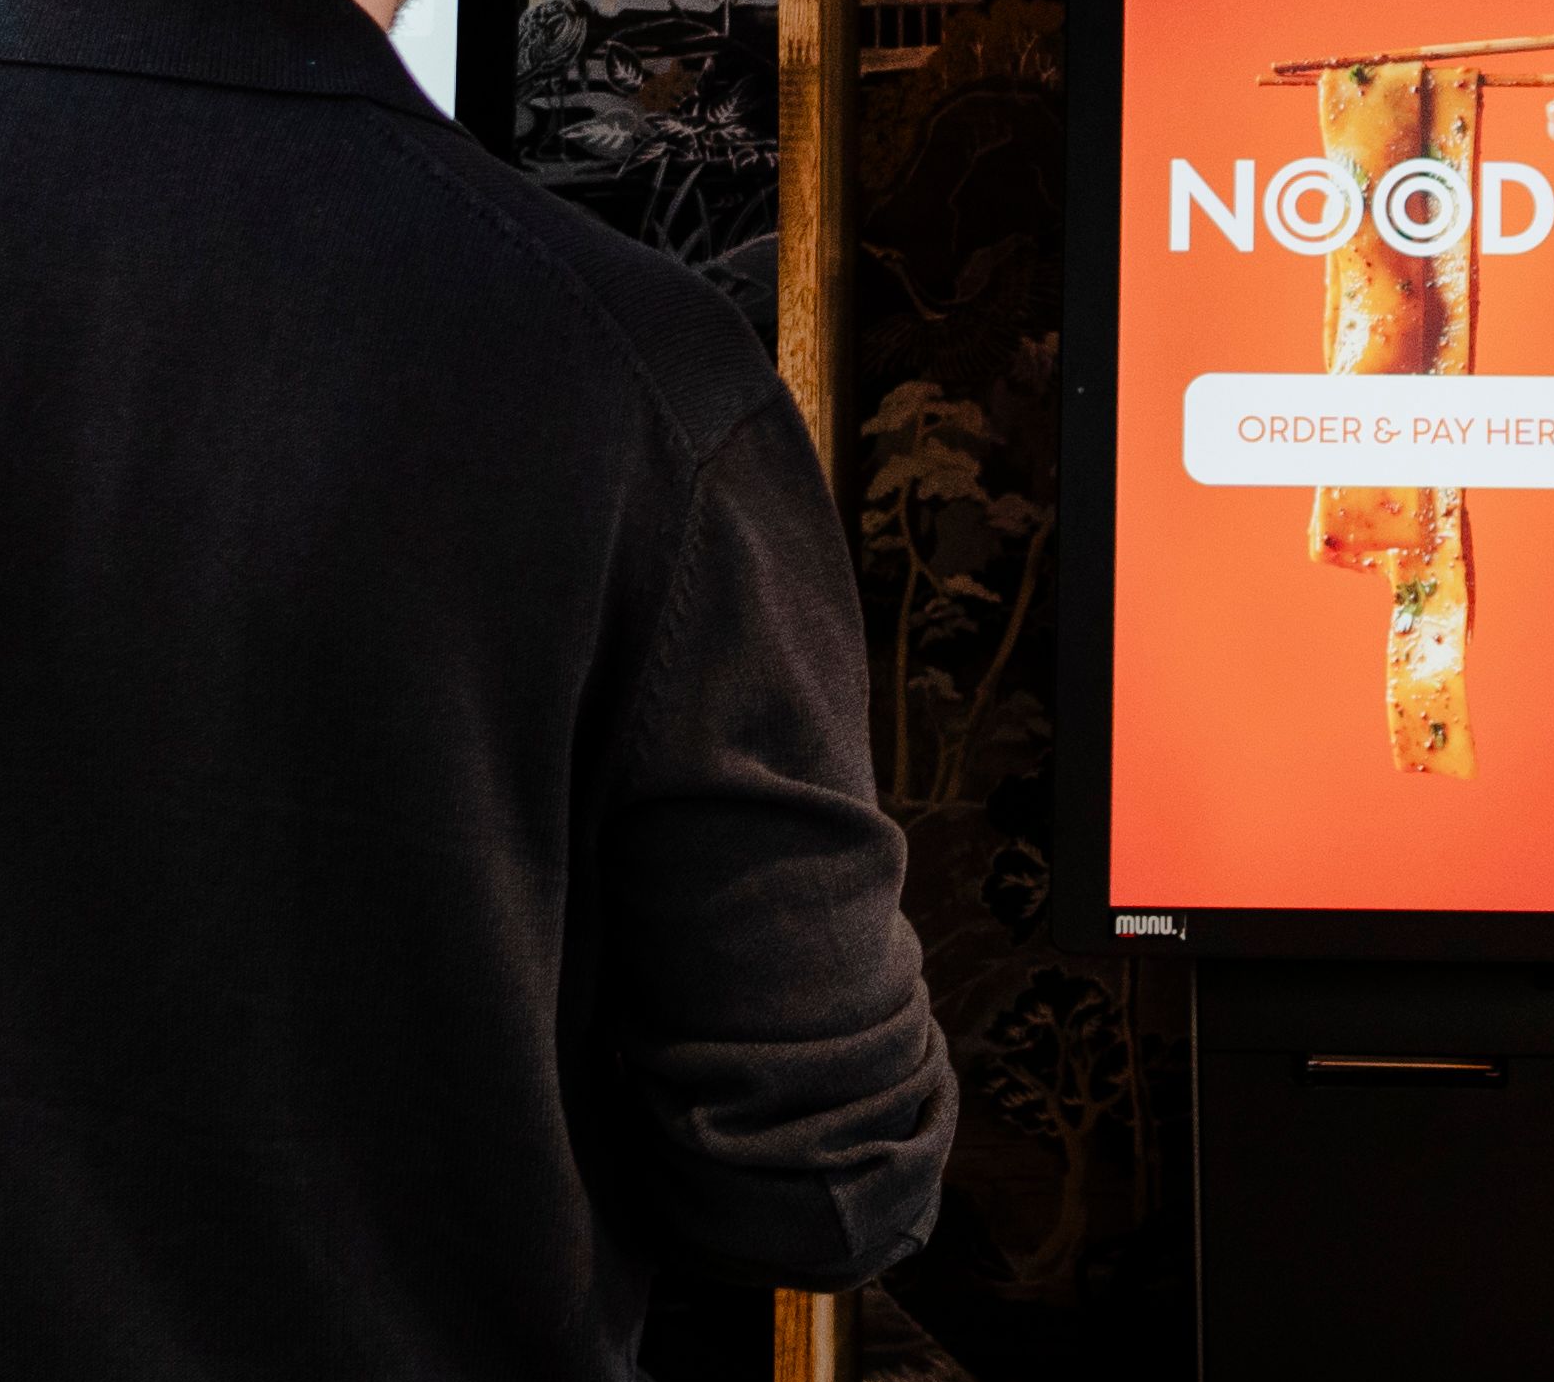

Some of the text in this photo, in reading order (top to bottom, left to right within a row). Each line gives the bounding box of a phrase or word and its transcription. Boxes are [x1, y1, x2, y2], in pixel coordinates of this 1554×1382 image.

[1238, 415, 1362, 444] ORDER
[1373, 415, 1402, 444] &
[1413, 416, 1475, 445] PAY
[1115, 914, 1177, 935] munu.
